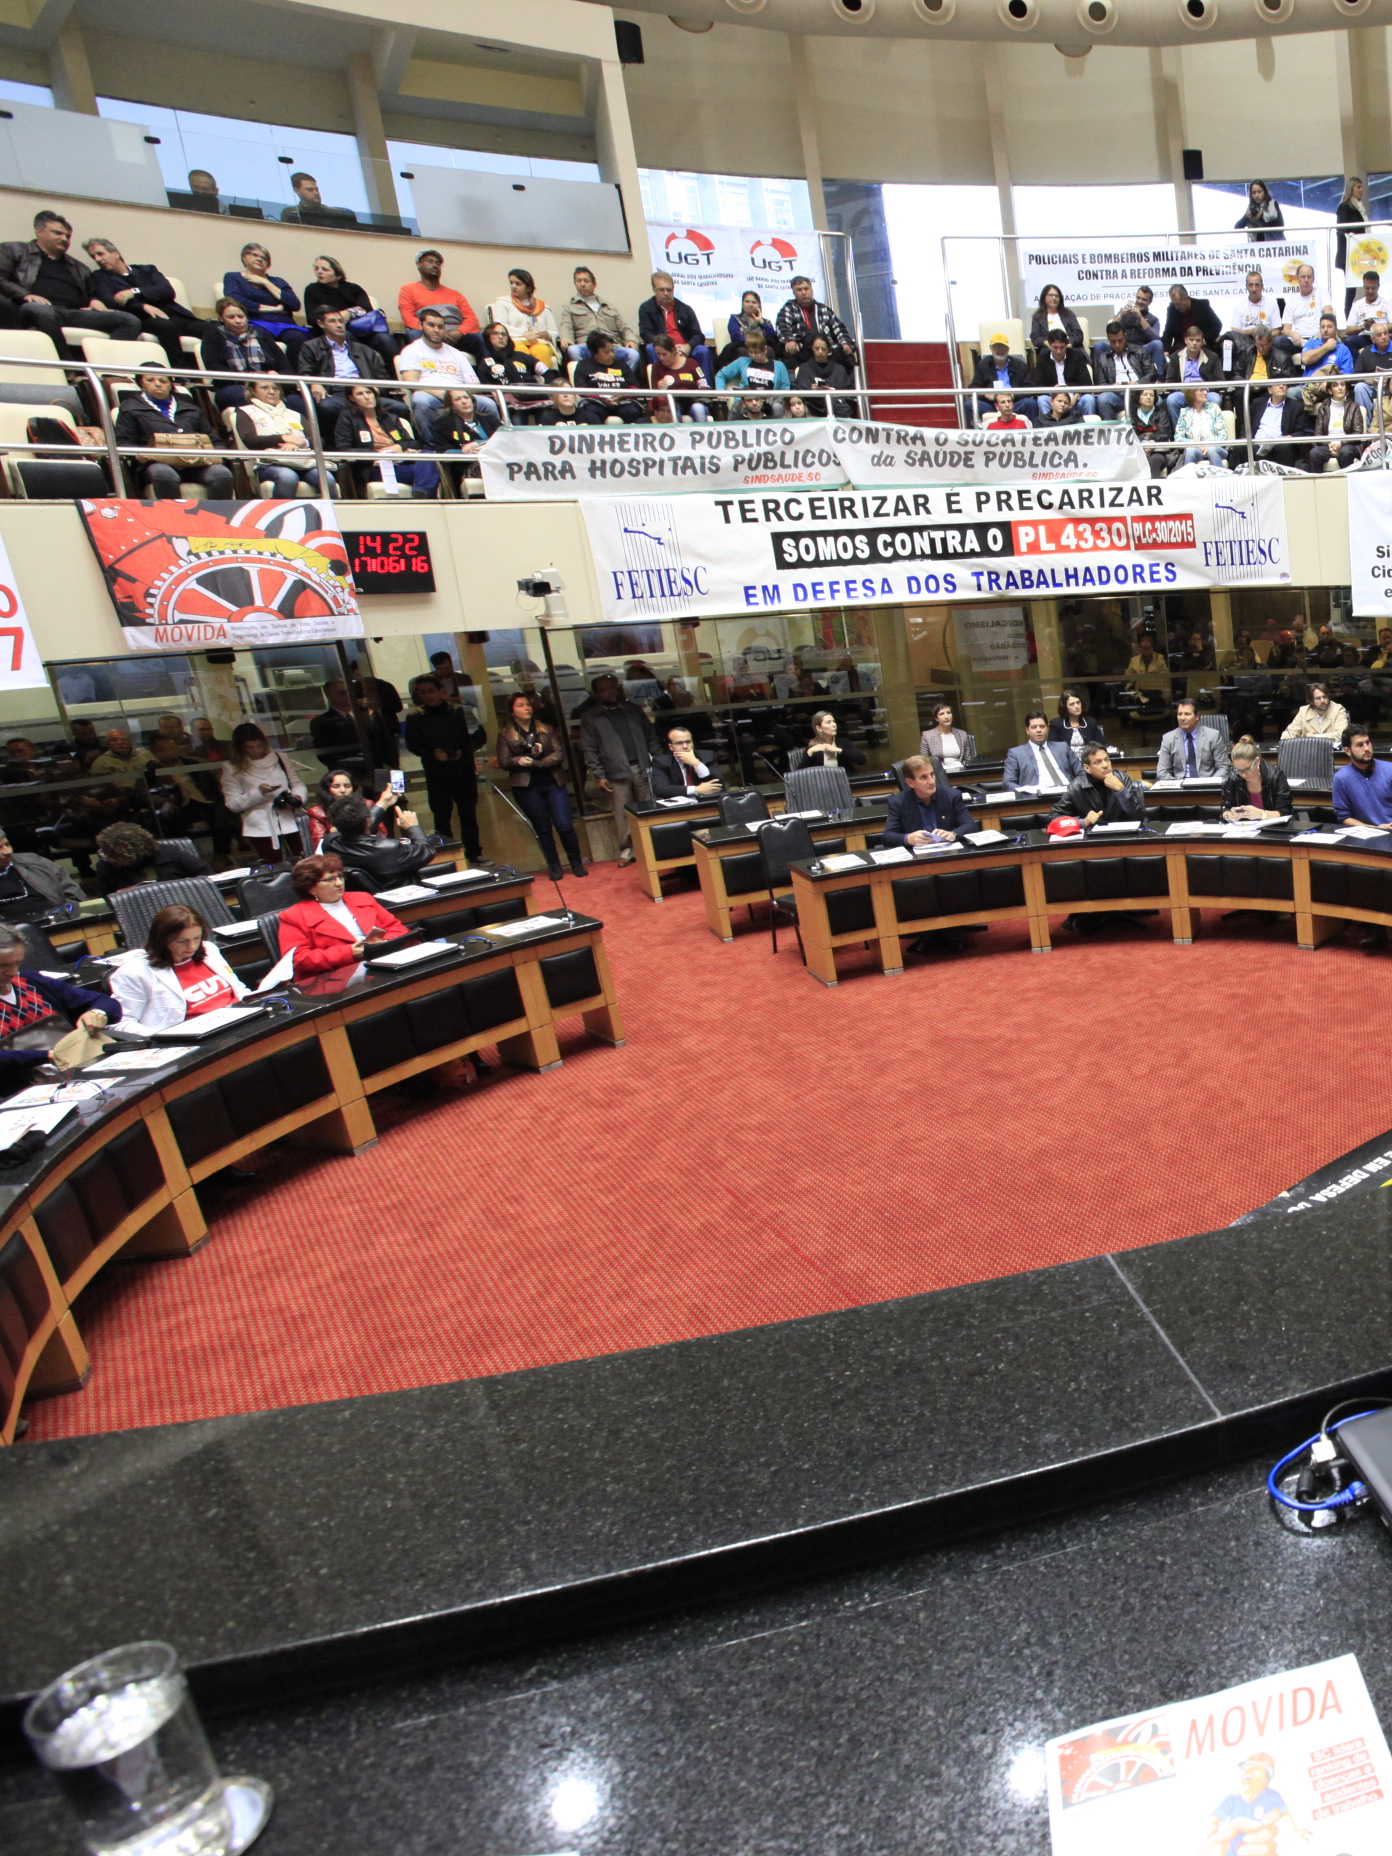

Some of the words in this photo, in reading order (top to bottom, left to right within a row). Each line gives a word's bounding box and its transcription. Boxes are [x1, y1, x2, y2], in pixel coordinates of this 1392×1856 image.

[665, 251, 715, 266] UGT
[751, 257, 797, 272] UGT
[1028, 253, 1080, 265] POLICIAIS
[1082, 254, 1088, 264] E
[1089, 252, 1151, 264] BOMBEIROS
[1152, 250, 1206, 262] MILITARES
[1208, 249, 1222, 260] DE
[1223, 247, 1257, 259] SANTA
[1258, 245, 1309, 258] CATARINA
[1077, 269, 1118, 281] CONTRA
[1120, 268, 1128, 279] A
[1130, 267, 1177, 279] REFORMA
[1179, 266, 1193, 277] DA
[1195, 263, 1262, 276] PREVIDÊNCIA
[1090, 293, 1101, 302] DE
[1202, 288, 1231, 297] SANTA
[548, 431, 676, 455] DINHEIRO
[691, 427, 795, 450] PÚBLICO
[833, 426, 927, 447] CONTRA
[935, 431, 948, 447] O
[956, 425, 1135, 447] SUCATEAMENTO
[507, 460, 577, 481] PARA
[588, 455, 721, 479] HOSPITAIS
[733, 447, 842, 472] PÚBLICOS
[871, 450, 896, 467] da
[904, 449, 975, 468] SAÚDE
[984, 446, 1088, 469] PÚBLICA.
[743, 470, 822, 485] SINDSAÚDE/SC
[715, 494, 932, 524] TERCEIRIZAR
[947, 487, 963, 514] É
[977, 484, 1164, 513] PRECARIZAR
[783, 535, 869, 563] SOMOS
[877, 528, 980, 557] CONTRA
[987, 527, 1003, 552] O
[1018, 530, 1055, 552] PL
[1061, 522, 1127, 549] 4330
[1134, 519, 1194, 545] PLC-30/2015
[1203, 536, 1280, 567] FETIESC
[611, 565, 710, 600] FETIESC
[744, 583, 782, 607] EM
[794, 577, 893, 603] DEFESA
[907, 572, 957, 595] DOS
[972, 561, 1177, 592] TRABALHADORES
[1384, 588, 1392, 598] e
[155, 624, 227, 643] MOVIDA
[183, 974, 230, 1003] CUT
[1362, 1157, 1392, 1173] EM
[1309, 1168, 1371, 1202] DEFESA
[1185, 1679, 1343, 1760] MOVIDA
[1313, 1748, 1331, 1762] SC
[1332, 1739, 1363, 1756] lidera
[1310, 1758, 1352, 1777] ranking
[1352, 1752, 1368, 1764] de
[1315, 1768, 1362, 1789] doenças
[1363, 1765, 1372, 1774] e
[1323, 1778, 1377, 1801] acidentes
[1315, 1808, 1330, 1819] de
